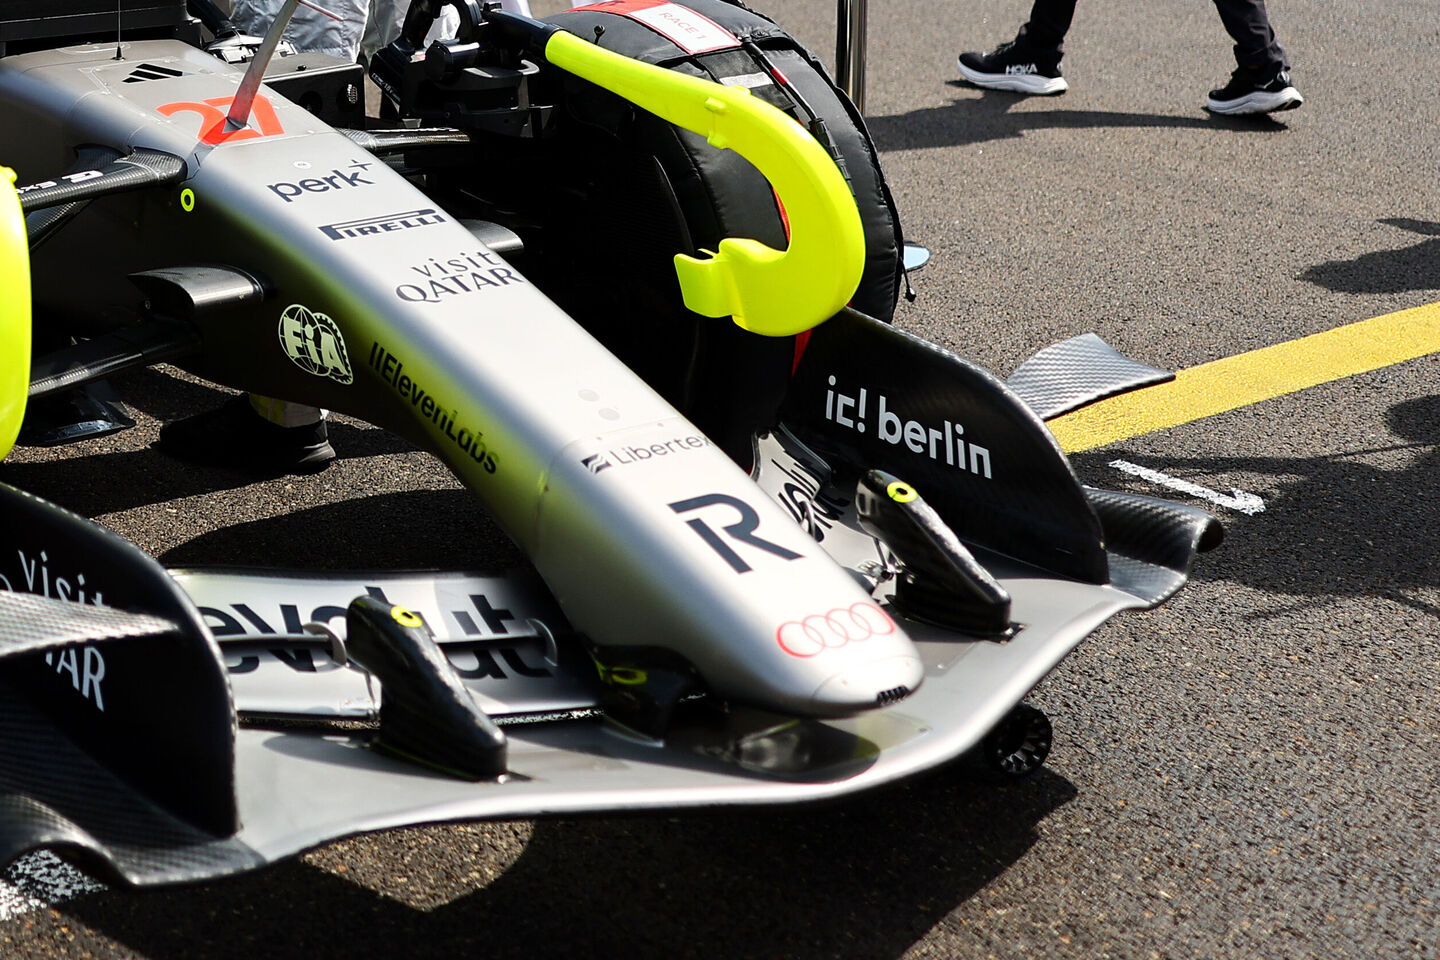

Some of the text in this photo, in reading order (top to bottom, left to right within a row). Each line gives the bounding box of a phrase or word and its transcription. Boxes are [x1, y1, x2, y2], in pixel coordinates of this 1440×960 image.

[659, 12, 699, 33] RACE
[155, 94, 286, 146] 27
[266, 159, 373, 203] perk+
[317, 208, 448, 241] PIRELLI
[411, 250, 502, 278] visit
[395, 266, 525, 304] QATAR
[609, 433, 713, 466] Libertex
[878, 394, 993, 480] berlin
[667, 492, 807, 575] R
